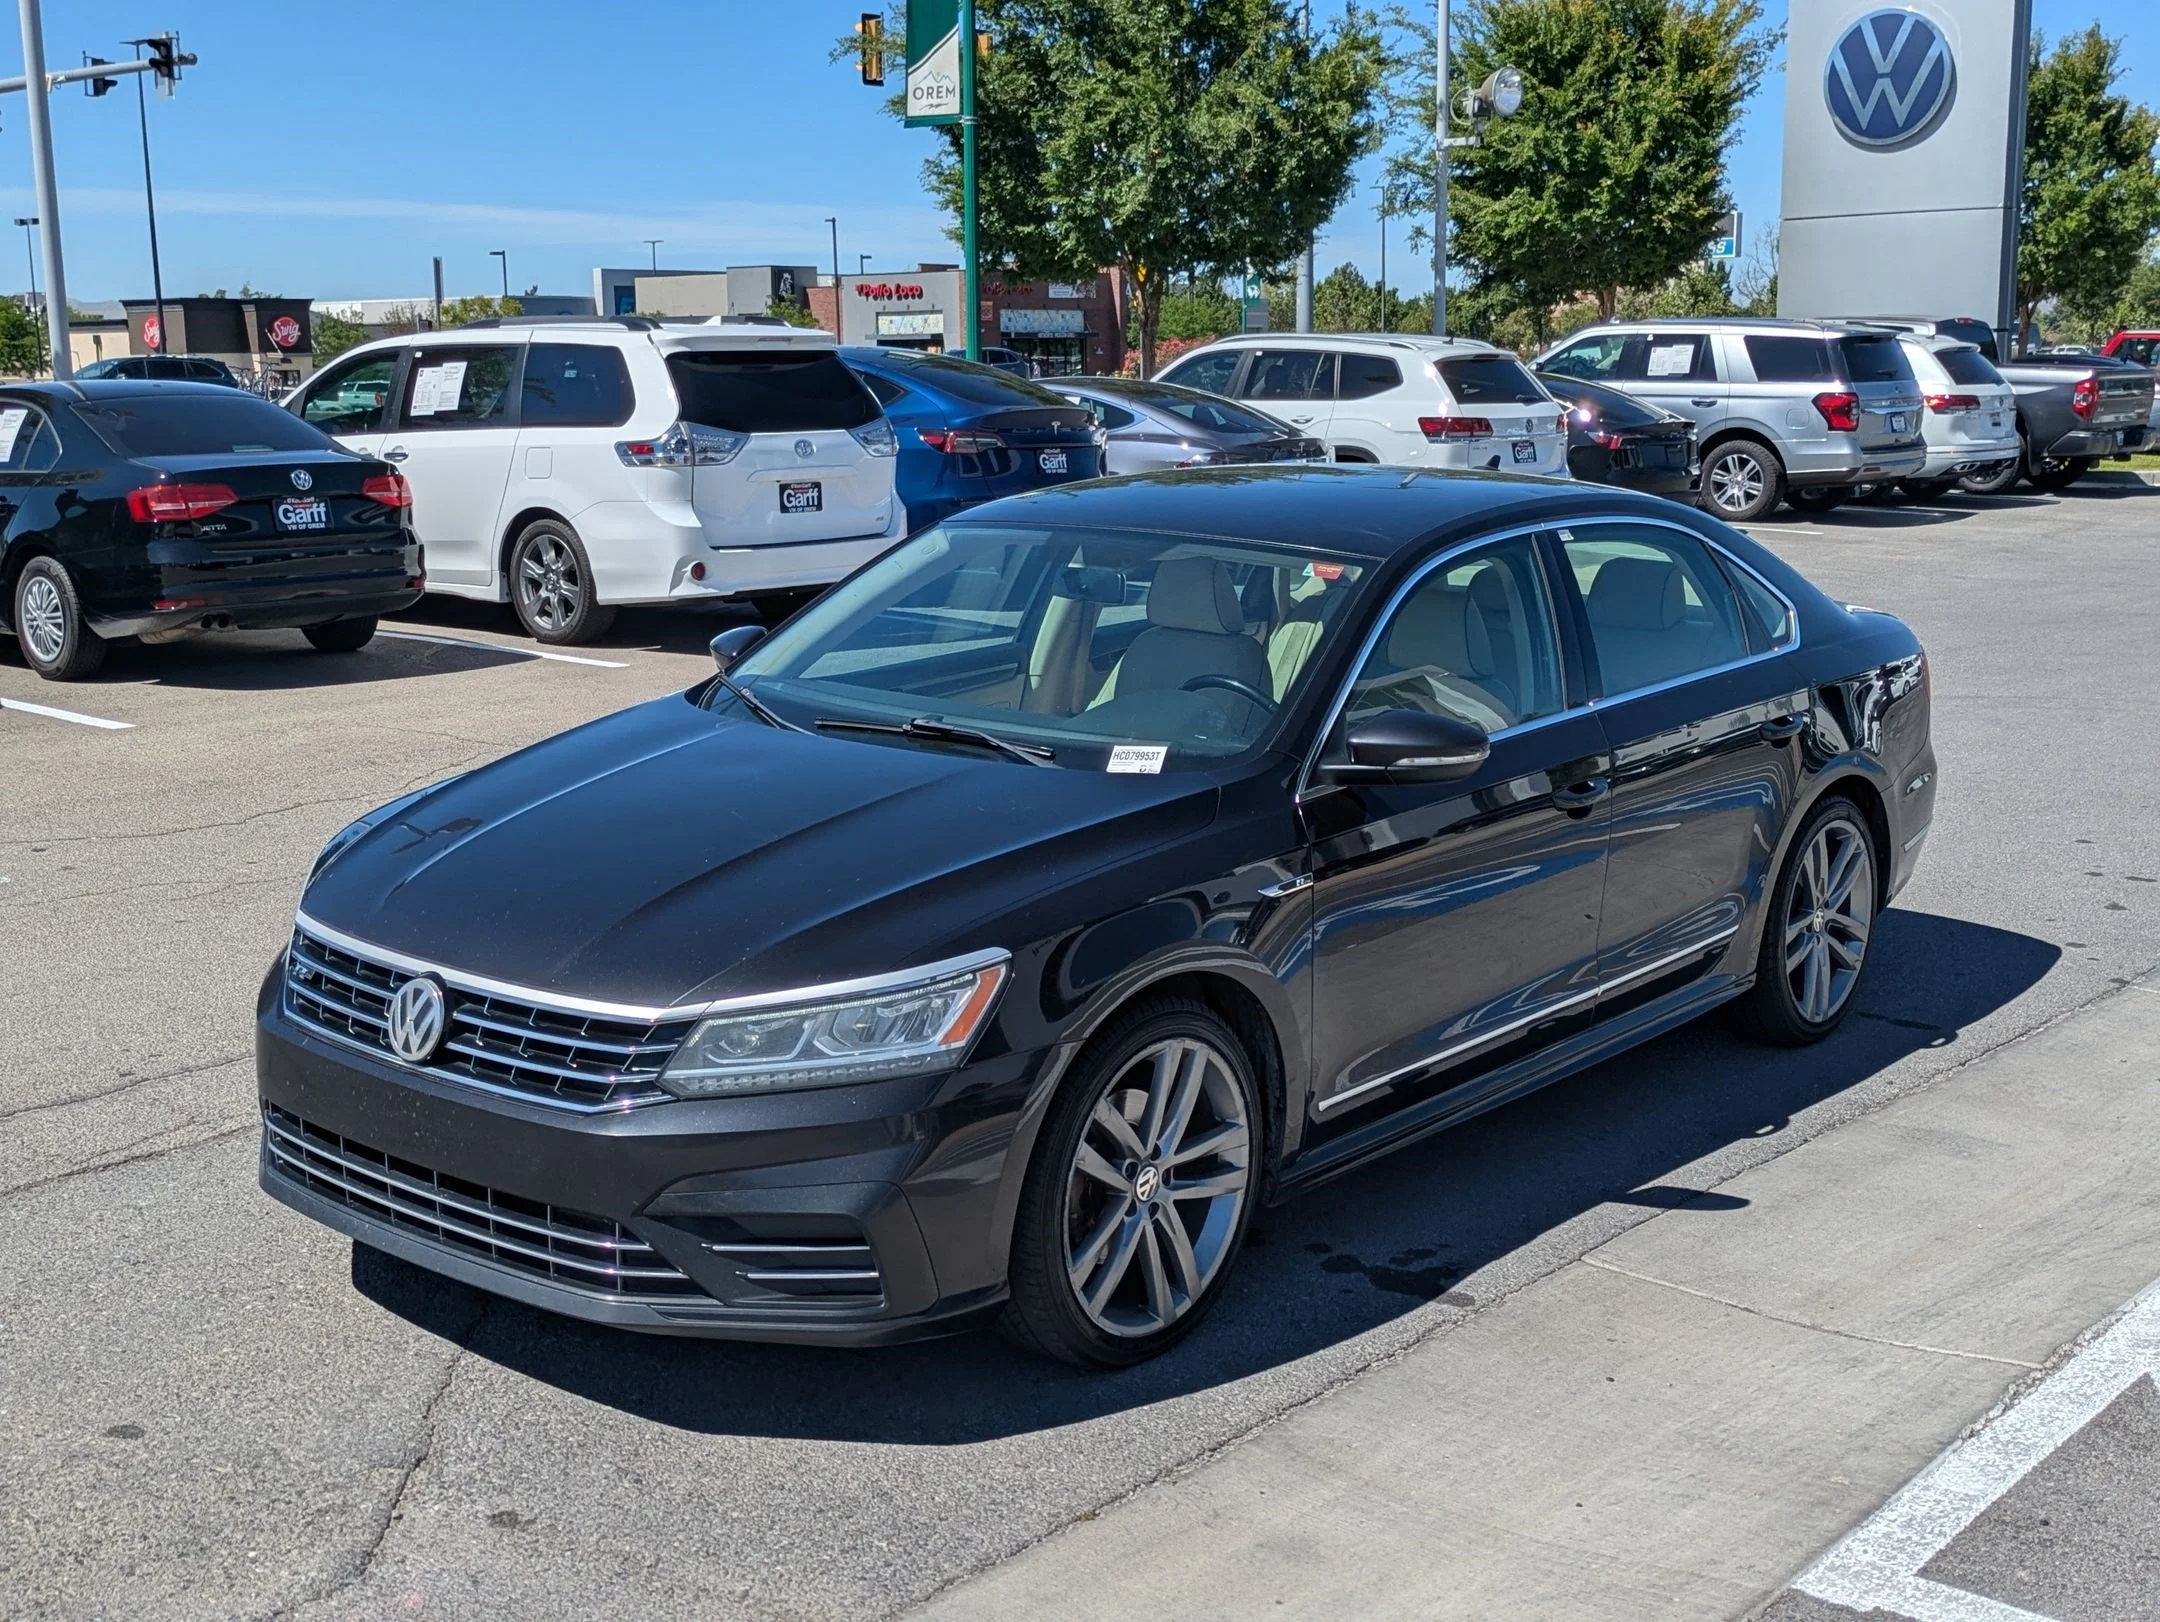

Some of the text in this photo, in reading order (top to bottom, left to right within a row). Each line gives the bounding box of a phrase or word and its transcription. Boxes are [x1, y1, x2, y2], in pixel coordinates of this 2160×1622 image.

[912, 84, 956, 101] OREM
[863, 284, 890, 297] Pollo
[894, 284, 921, 296] Loco
[272, 320, 301, 342] Swig
[1039, 453, 1067, 469] Garff
[783, 487, 819, 507] Garff
[278, 502, 327, 524] Garff
[1112, 751, 1162, 761] HC079953T
